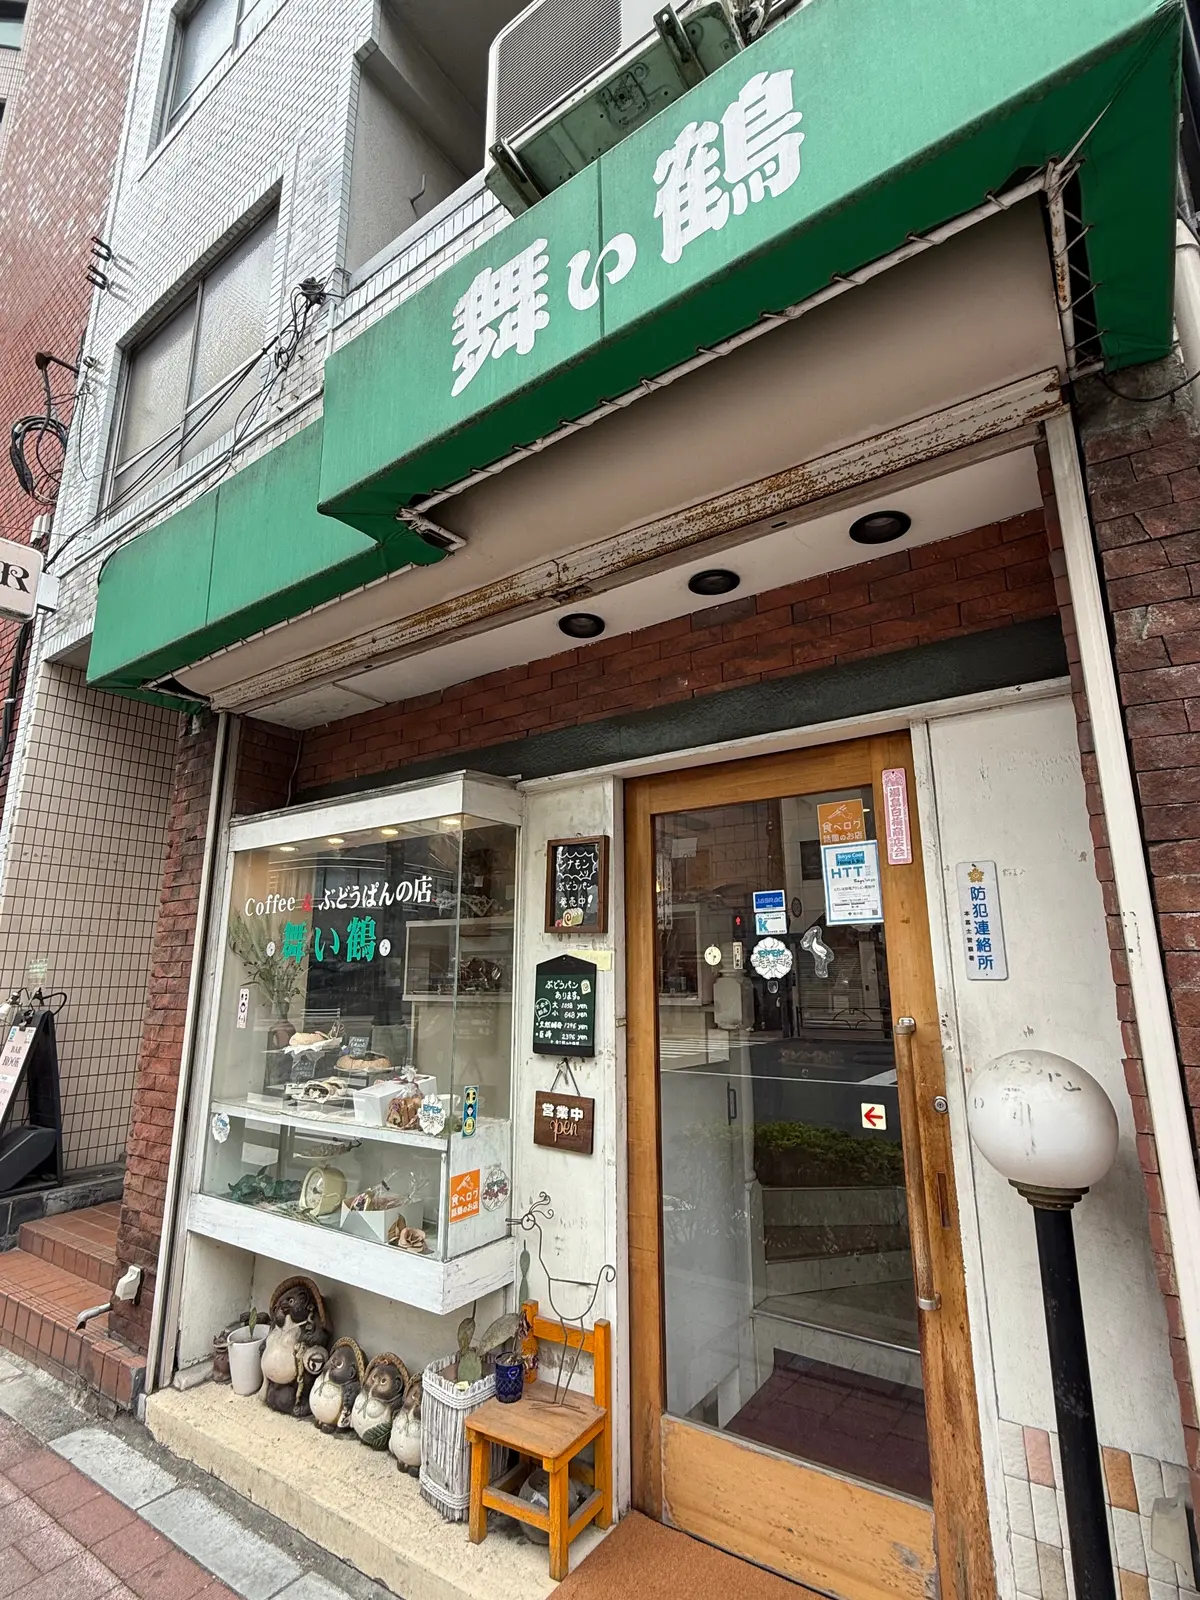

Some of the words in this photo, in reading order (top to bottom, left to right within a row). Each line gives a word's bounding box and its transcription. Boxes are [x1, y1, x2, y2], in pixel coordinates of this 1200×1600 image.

[451, 69, 805, 397] 舞い鶴
[831, 866, 863, 879] HTT
[245, 893, 296, 917] Coffee
[318, 876, 433, 911] ぶどうぱんの店
[281, 915, 377, 964] 舞い鶴
[970, 886, 994, 971] 防犯連絡所
[542, 1103, 584, 1121] 営業中
